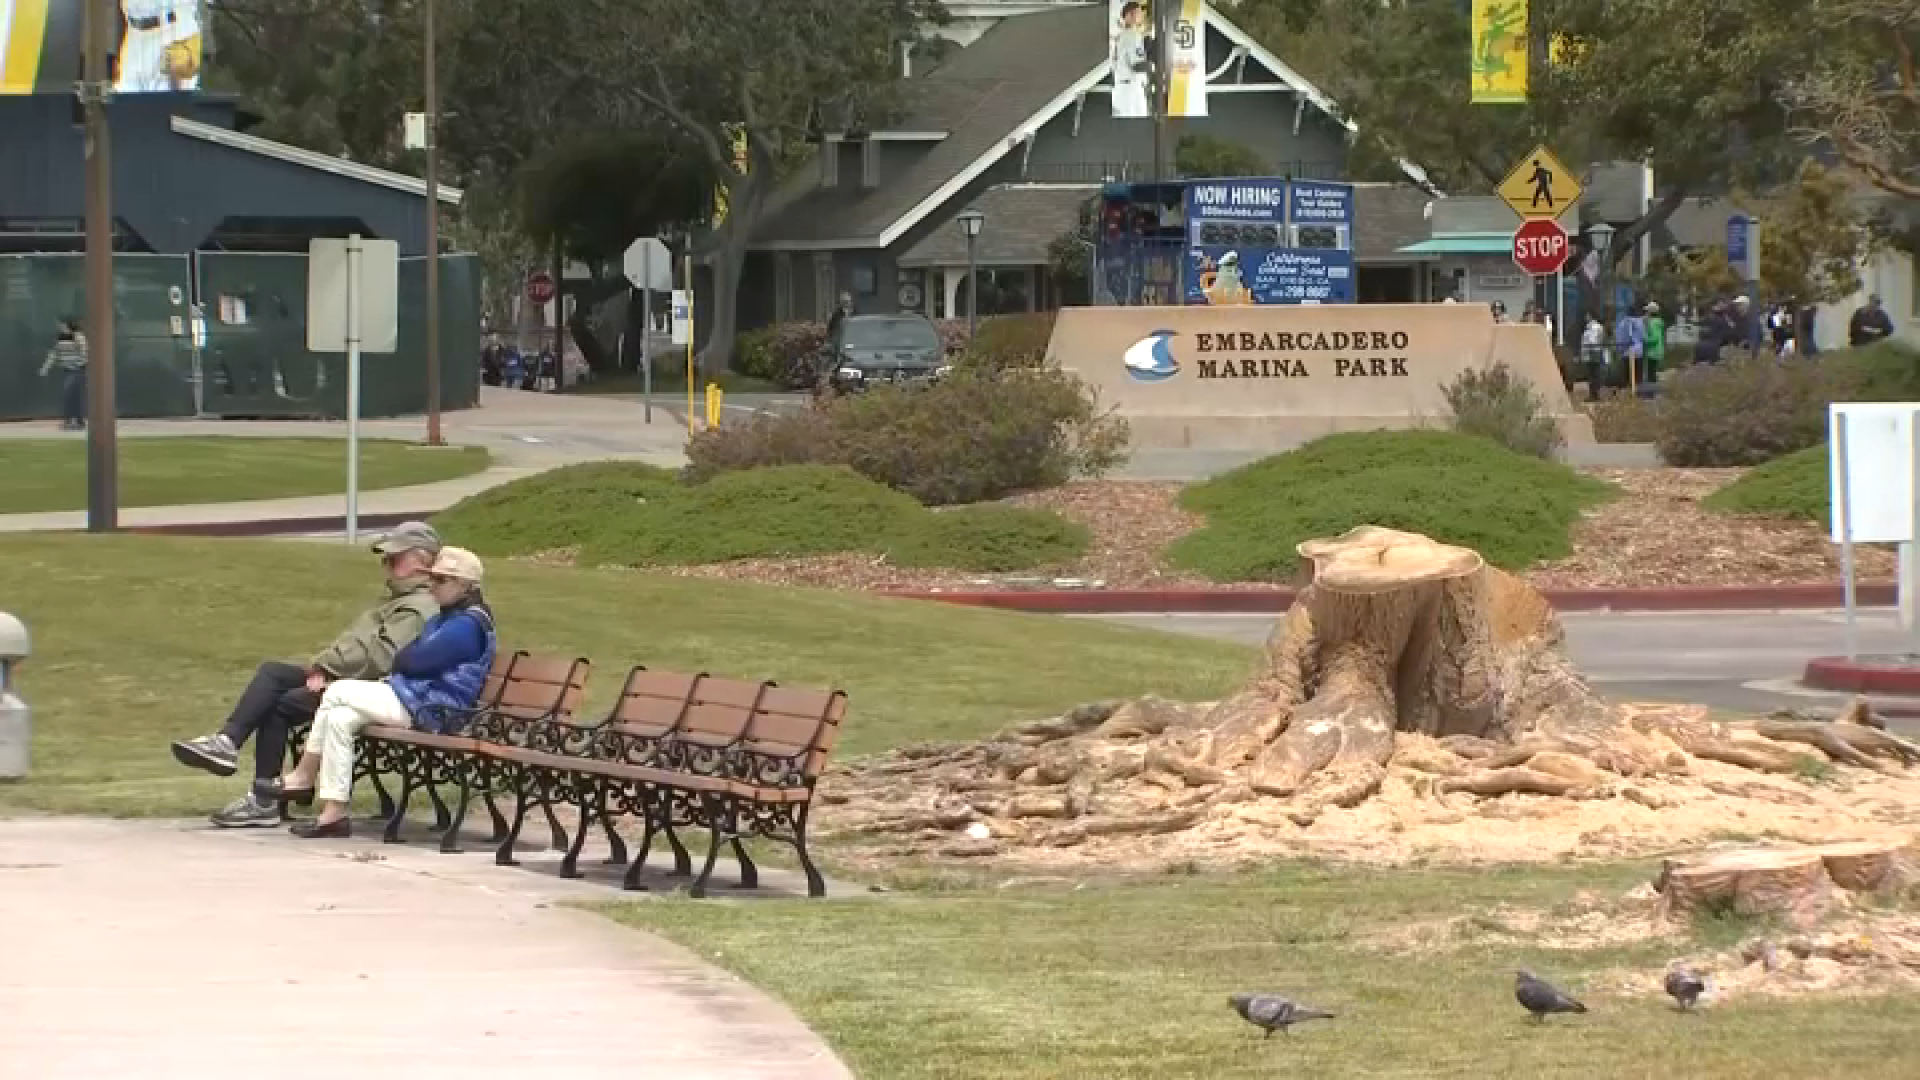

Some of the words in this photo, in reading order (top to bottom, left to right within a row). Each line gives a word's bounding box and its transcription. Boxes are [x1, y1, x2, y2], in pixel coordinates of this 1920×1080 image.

[1194, 186, 1227, 205] NOW
[1231, 186, 1280, 206] HIRING
[1516, 236, 1564, 259] STOP
[1195, 331, 1410, 353] EMBARCADERO
[1197, 359, 1310, 379] MARINA
[1334, 357, 1410, 378] PARK
